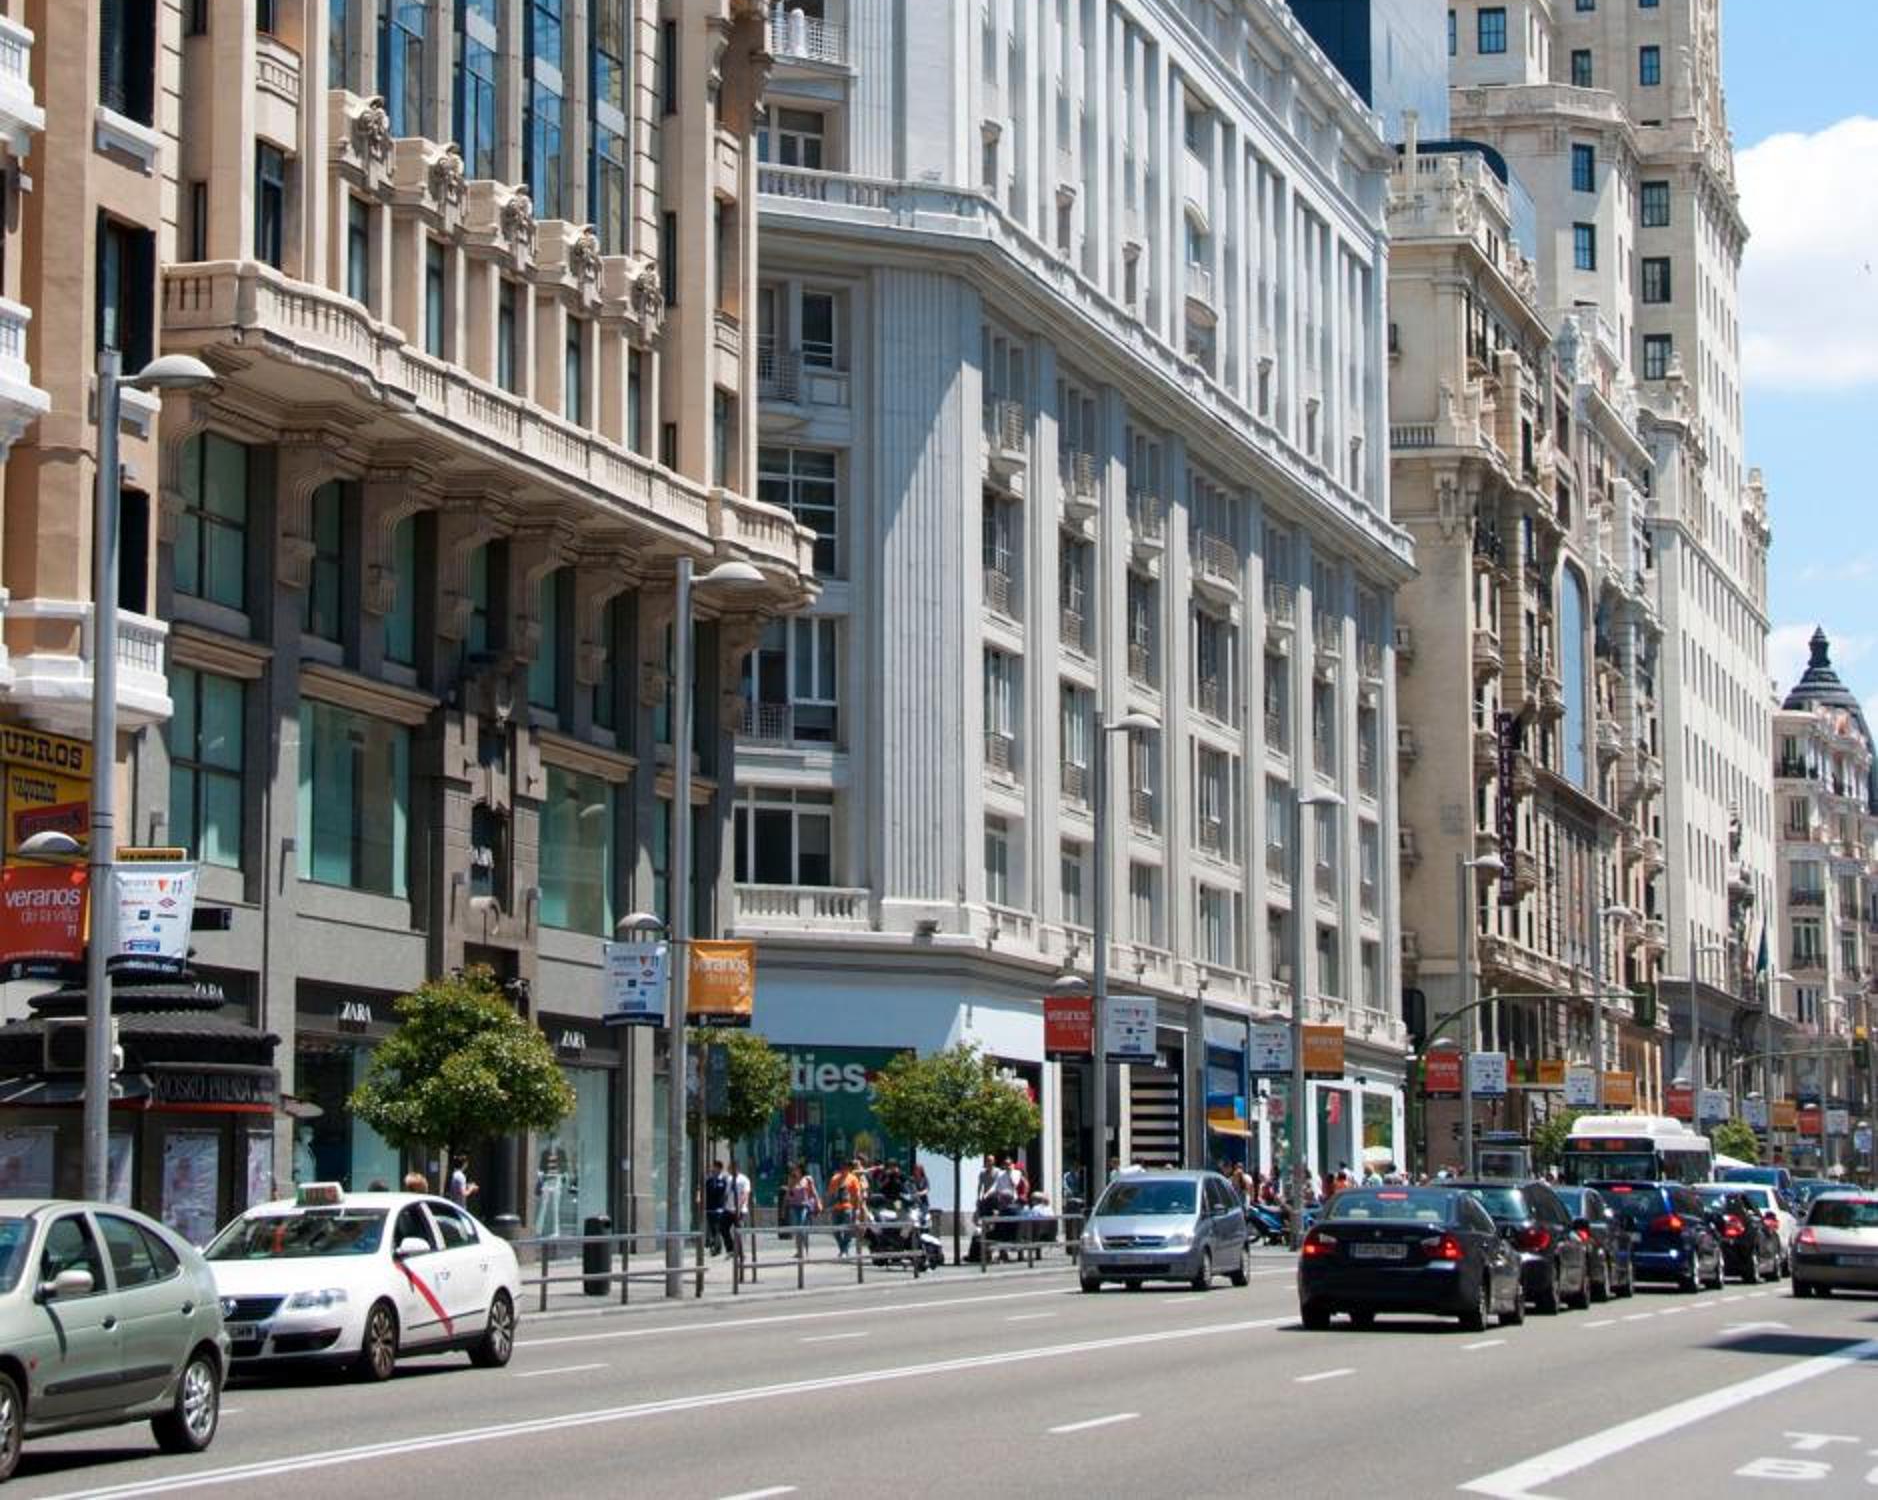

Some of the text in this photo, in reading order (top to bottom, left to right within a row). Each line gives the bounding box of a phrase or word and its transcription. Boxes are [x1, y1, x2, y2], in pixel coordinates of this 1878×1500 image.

[0, 730, 82, 771] UEROS
[5, 888, 81, 908] veranos
[341, 1001, 373, 1023] ZARA
[561, 1030, 586, 1049] ZARA
